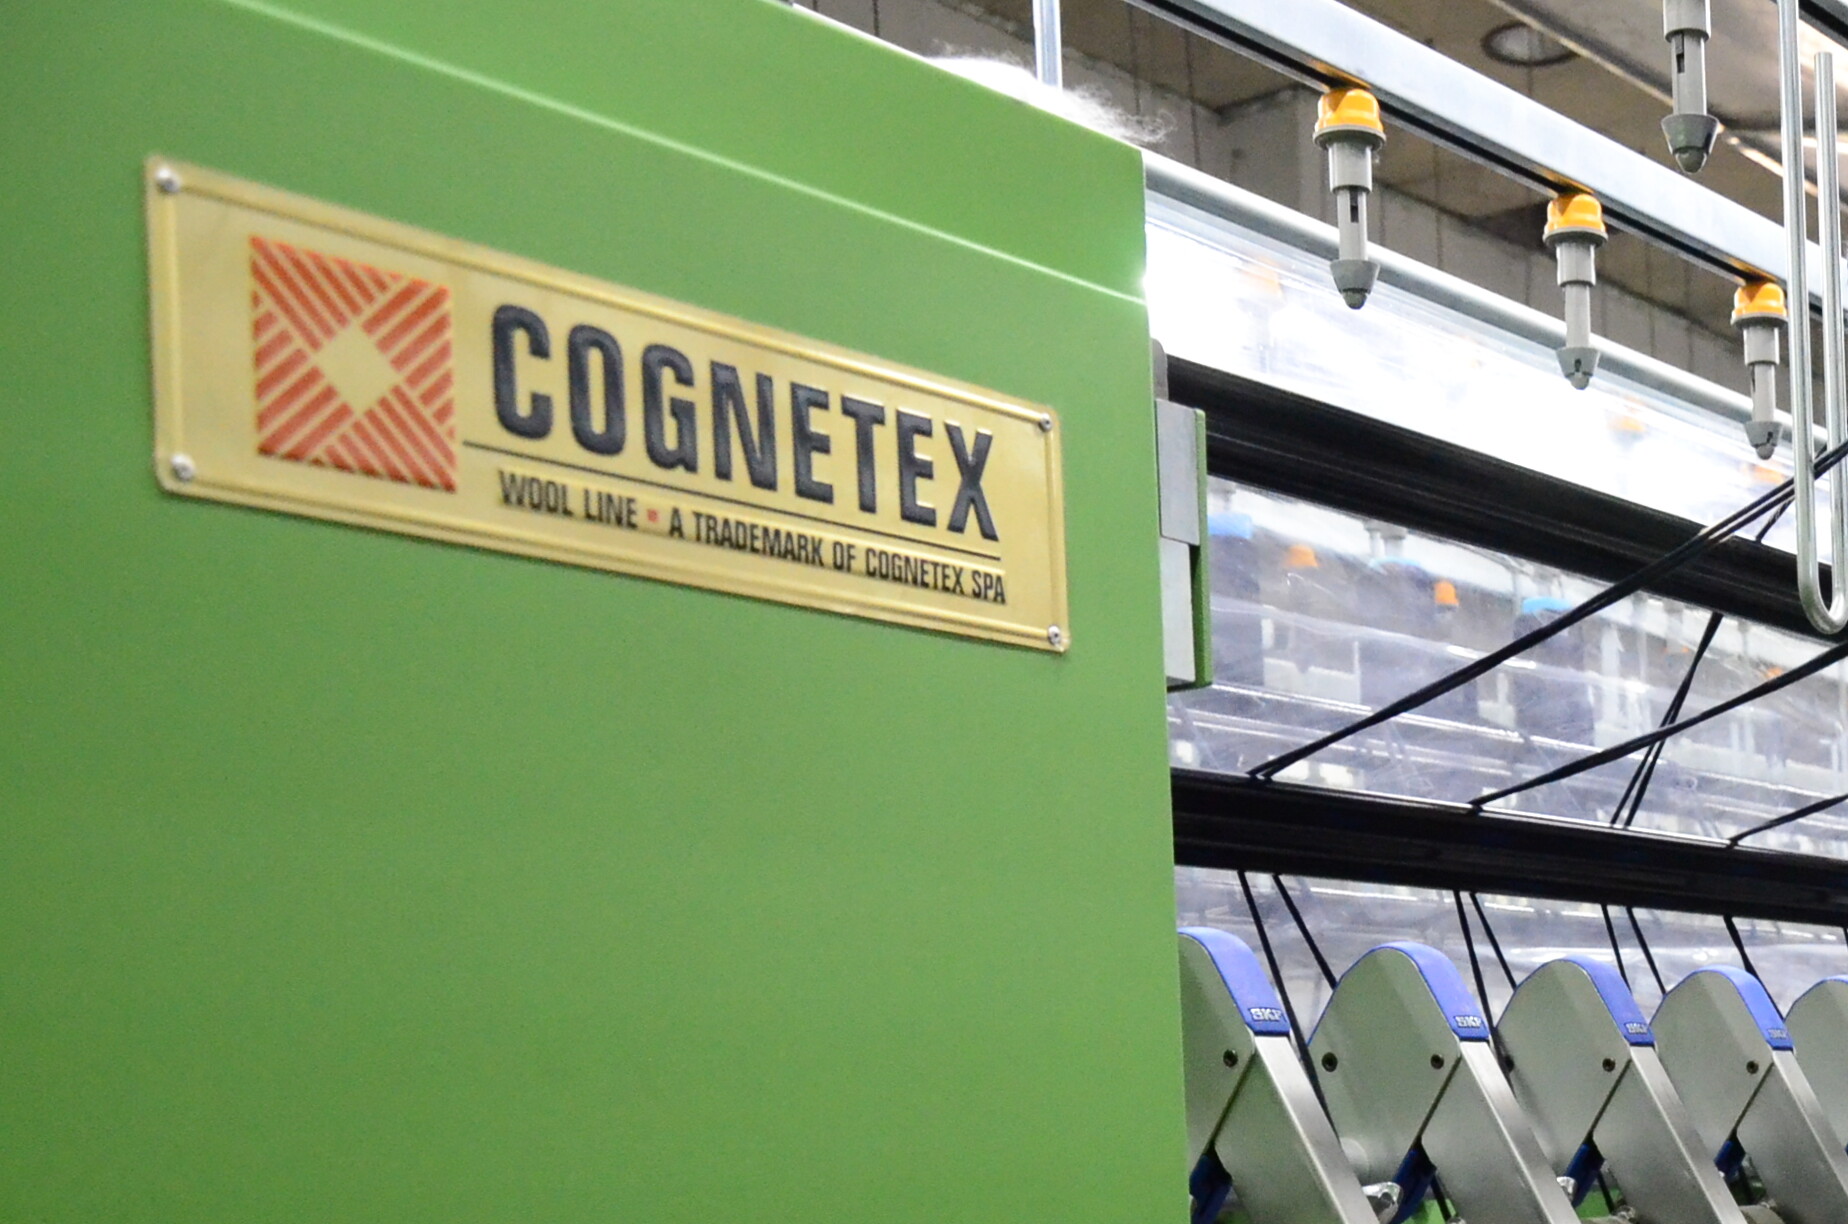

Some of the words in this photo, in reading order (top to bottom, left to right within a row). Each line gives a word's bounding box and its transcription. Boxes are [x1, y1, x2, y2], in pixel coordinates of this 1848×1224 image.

[492, 304, 999, 542] COGNETEX
[498, 470, 574, 517] WOOL
[583, 488, 638, 530] LINE
[669, 507, 684, 539] A
[692, 511, 825, 567] TRADEMARK
[832, 541, 857, 573] OF
[865, 547, 965, 595] COGNETEX
[971, 569, 1007, 605] SPA
